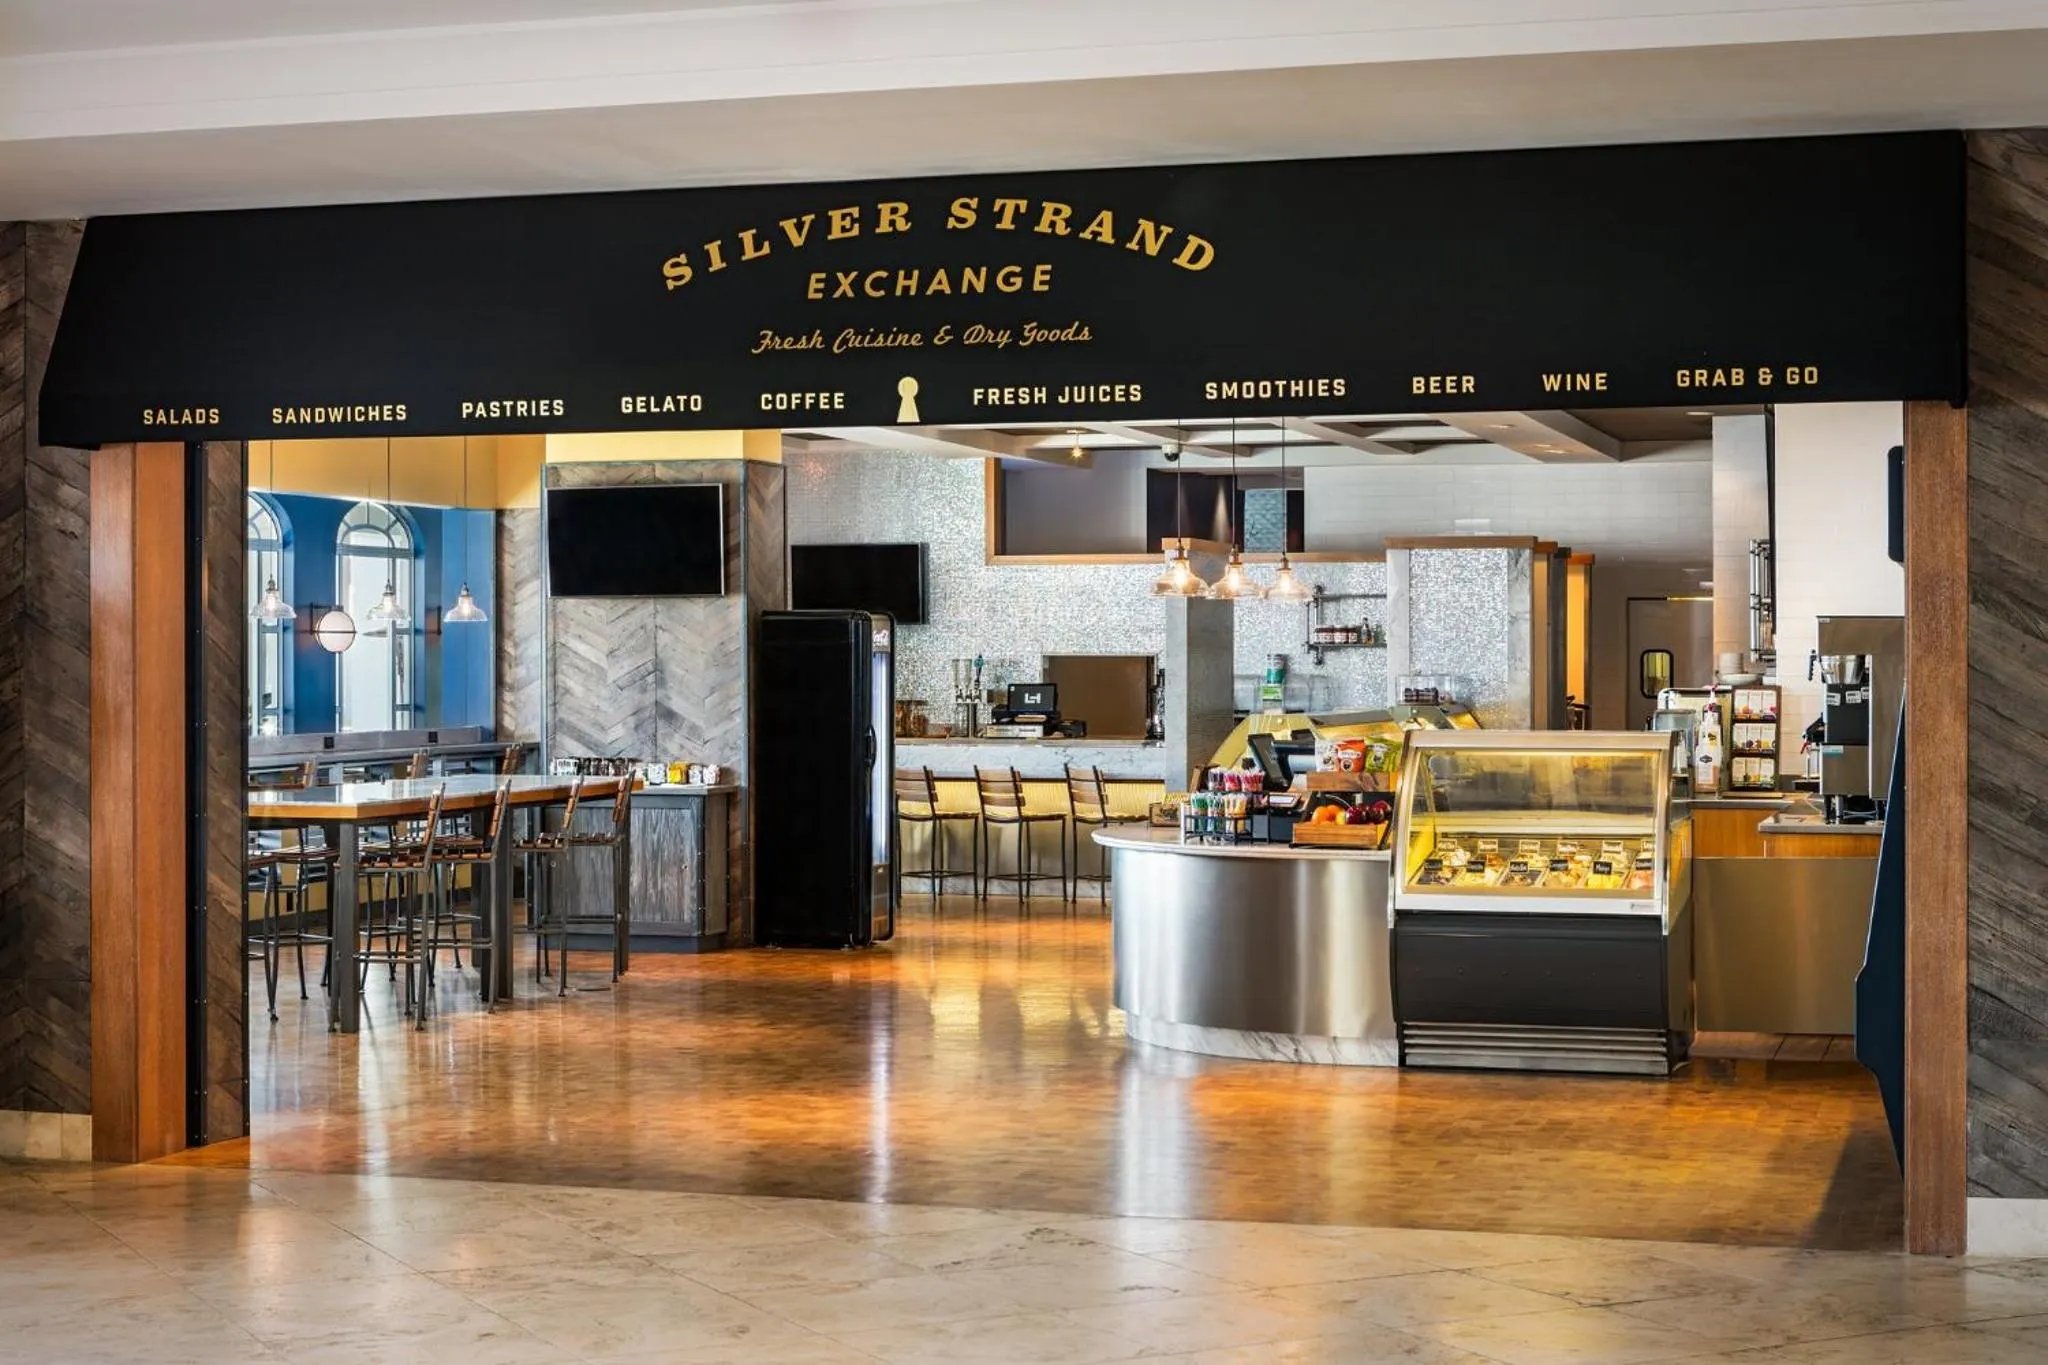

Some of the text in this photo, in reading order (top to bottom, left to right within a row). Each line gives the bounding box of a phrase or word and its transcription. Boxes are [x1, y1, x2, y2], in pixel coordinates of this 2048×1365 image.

[662, 197, 1215, 291] SILVER STRAND
[807, 264, 1052, 300] EXCHANGE
[752, 321, 1093, 354] Fresh Cuisine & Dry Goods
[1412, 375, 1475, 394] BEER
[1541, 372, 1608, 391] WINE
[1676, 366, 1818, 387] GRAB & GO
[973, 384, 1142, 406] FRESH JUICES
[1205, 378, 1346, 400] SMOOTHIES
[461, 399, 565, 419] PASTRIES
[620, 394, 702, 414] GELATO
[760, 392, 846, 411] COFFEE
[143, 408, 220, 425] SALADS
[272, 404, 407, 424] SANDWICHES
